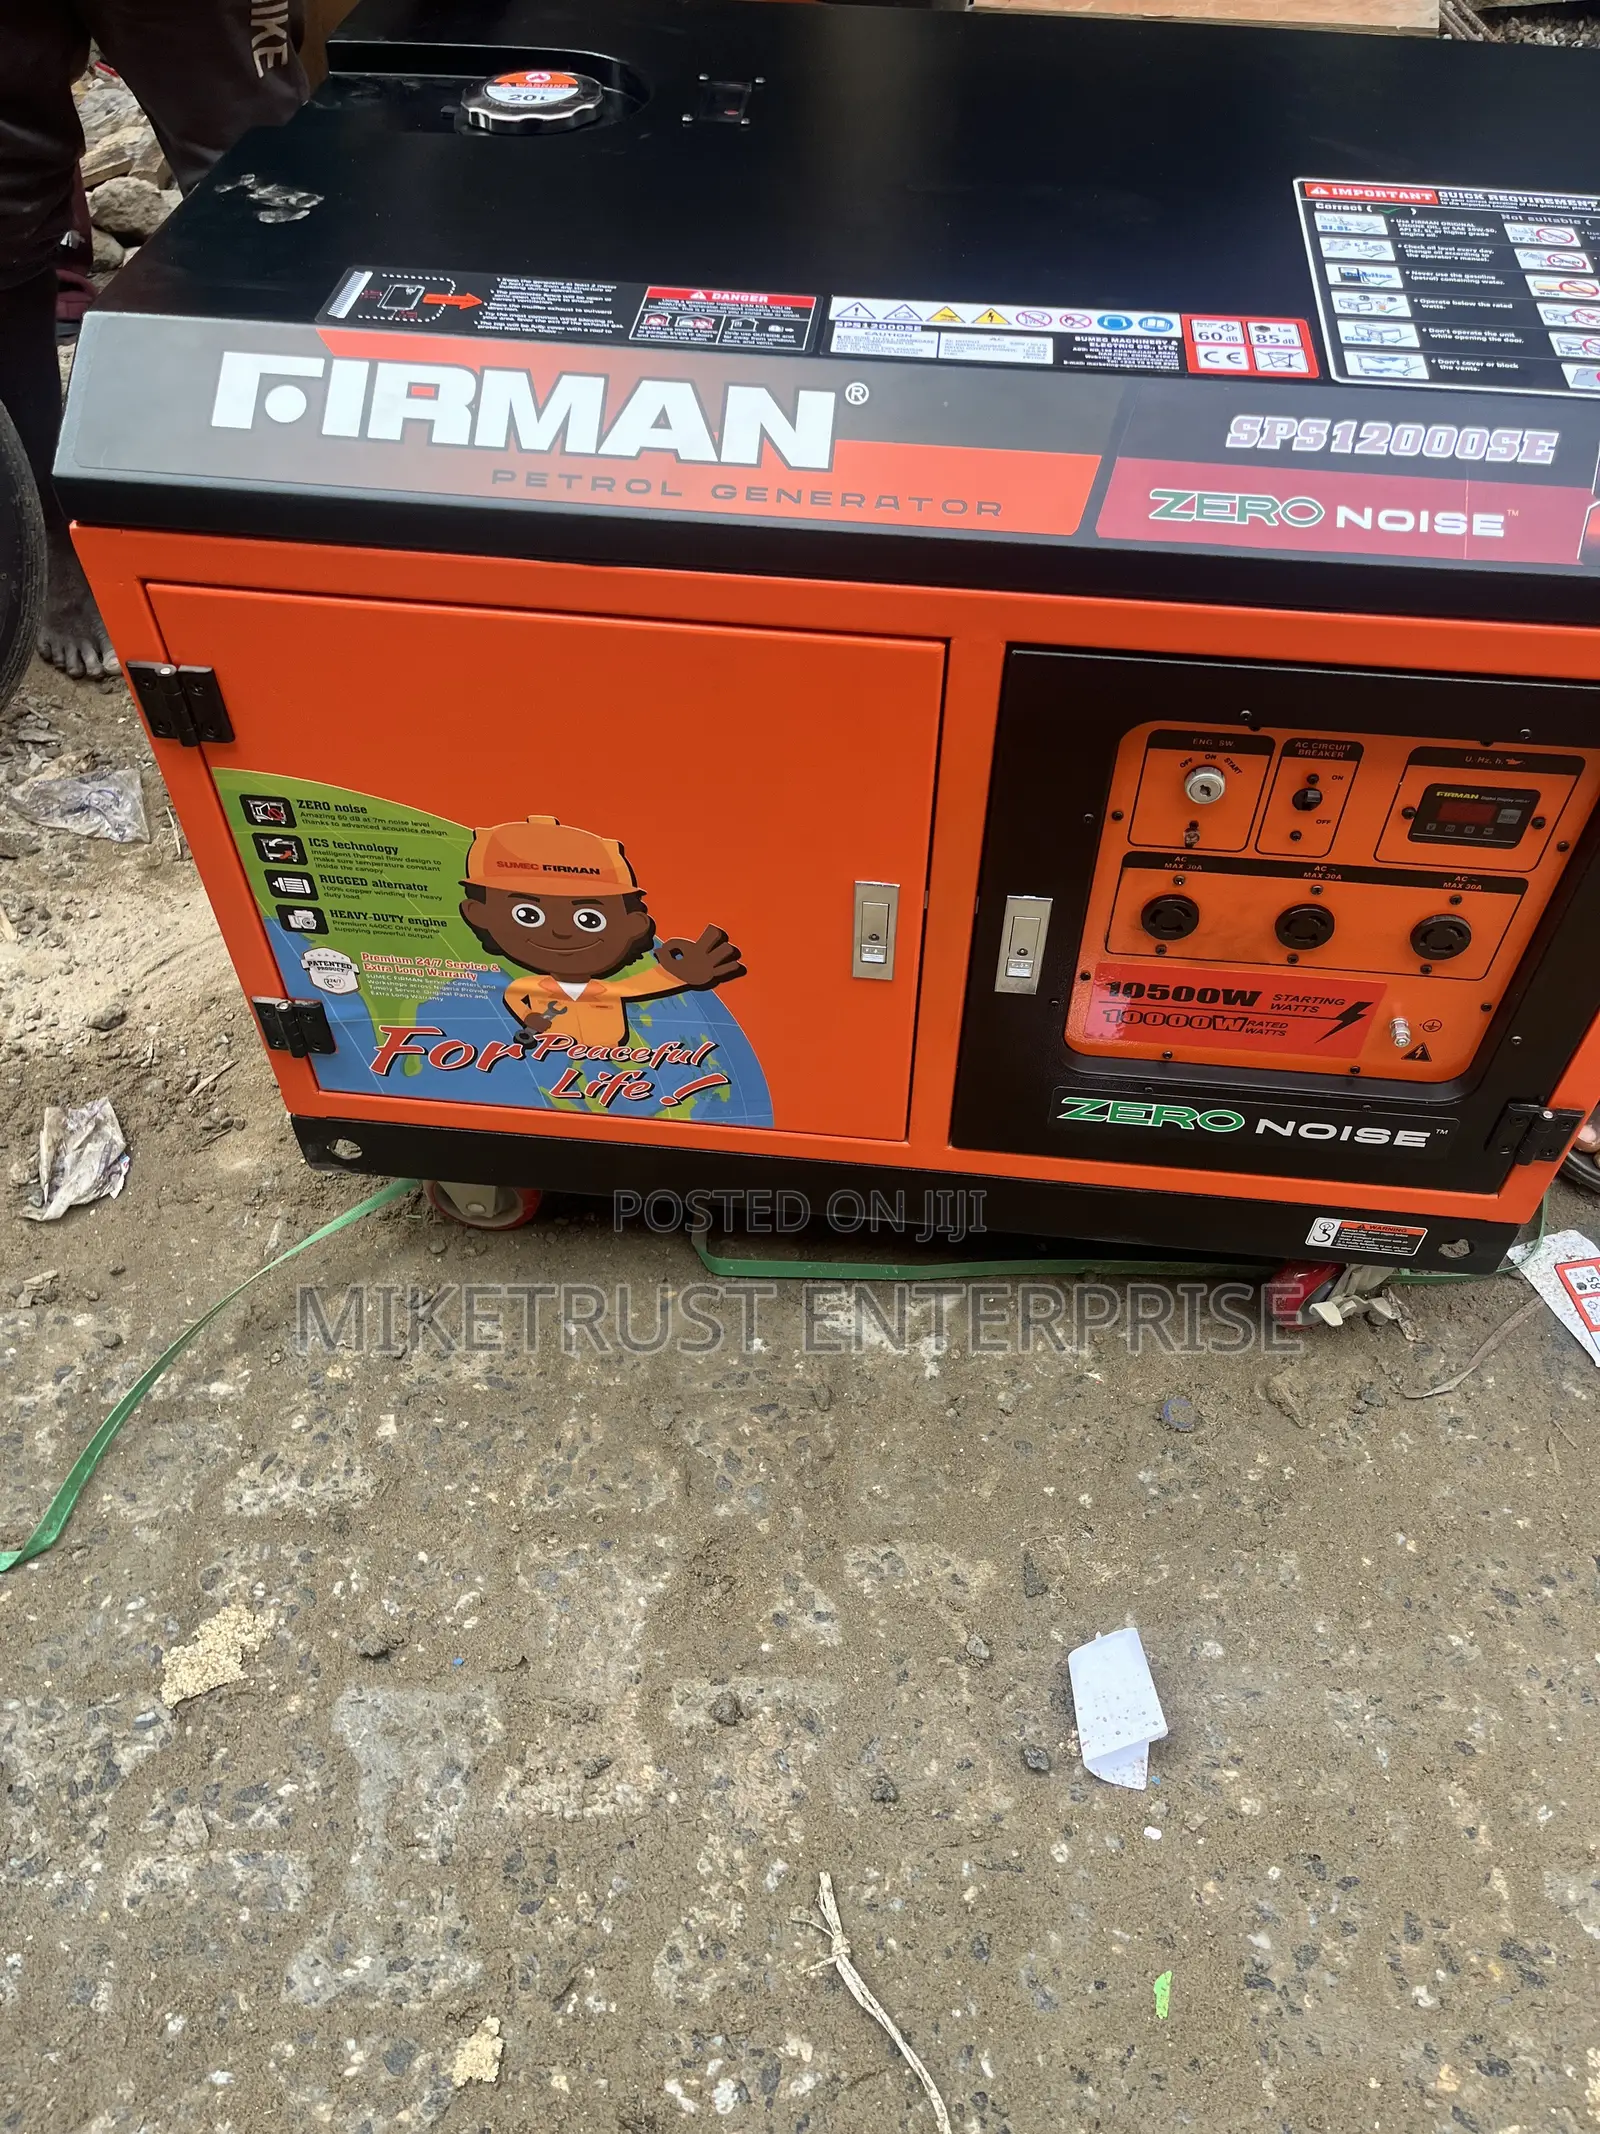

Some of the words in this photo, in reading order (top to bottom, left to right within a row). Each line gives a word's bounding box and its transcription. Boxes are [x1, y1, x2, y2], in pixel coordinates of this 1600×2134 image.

[251, 0, 289, 78] IKE
[1331, 187, 1432, 200] IMPORTANT
[1438, 191, 1485, 200] QUICK
[1315, 202, 1362, 212] Correct
[1500, 213, 1523, 221] Not
[1528, 215, 1581, 225] suitable
[711, 292, 768, 303] DANGER
[835, 321, 922, 331] SPS12000SE
[1111, 337, 1168, 346] MACHINERY
[1198, 331, 1223, 341] 60
[1255, 334, 1280, 344] 85
[1089, 342, 1134, 350] ELECTRIC
[1204, 351, 1242, 364] CE
[1437, 358, 1460, 366] Don't
[1496, 361, 1519, 369] block
[210, 351, 836, 469] FIRMAN
[1225, 414, 1560, 465] SPS12000SE
[492, 469, 683, 497] PETROL
[710, 483, 1002, 517] GENERATOR
[1149, 488, 1326, 527] ZERO
[1336, 505, 1505, 537] NOISE
[1294, 741, 1309, 749] AC
[1311, 742, 1352, 751] CIRCUIT
[1297, 749, 1344, 758] BREAKER
[1179, 757, 1193, 768] OFF
[1223, 757, 1243, 775] START
[1436, 791, 1479, 800] FIRMAN
[296, 799, 330, 811] ZERO
[334, 803, 368, 814] noise
[300, 811, 336, 821] Amazing
[411, 820, 430, 828] level
[302, 818, 330, 826] thanks
[341, 822, 380, 831] advanced
[381, 825, 419, 834] acoustics
[308, 837, 329, 848] ICS
[332, 839, 398, 856] technology
[353, 852, 384, 860] thermal
[405, 857, 431, 865] design
[354, 860, 405, 869] temperature
[406, 864, 441, 872] constant
[496, 860, 540, 870] SUMEC
[542, 864, 601, 875] FIRMAN
[1186, 863, 1203, 871] 30A
[318, 874, 368, 887] RUGGED
[371, 878, 428, 892] alternator
[323, 891, 341, 899] duty
[345, 887, 372, 895] copper
[374, 889, 406, 899] winding
[329, 909, 404, 924] HEAVY-DUTY
[408, 917, 448, 928] engine
[332, 920, 368, 928] Premium
[334, 926, 371, 935] supplying
[372, 929, 406, 937] powerful
[307, 960, 353, 970] PATENTED
[361, 952, 413, 965] Premium
[415, 957, 442, 967] 24/7
[445, 959, 488, 971] Service
[490, 963, 501, 972] &
[363, 962, 393, 973] Extra
[394, 965, 424, 977] Long
[426, 967, 478, 982] Warranty
[1106, 981, 1263, 1007] 10500W
[1272, 993, 1346, 1006] STARTING
[1270, 1002, 1320, 1013] WATTS
[1103, 1009, 1249, 1032] 10000W
[1246, 1019, 1289, 1029] RATED
[1244, 1028, 1287, 1037] WATTS
[368, 1024, 527, 1076] For
[530, 1032, 720, 1071] Peaceful
[1056, 1096, 1246, 1133] ZERO
[1254, 1118, 1431, 1148] NOISE
[1369, 1225, 1408, 1233] WARNING
